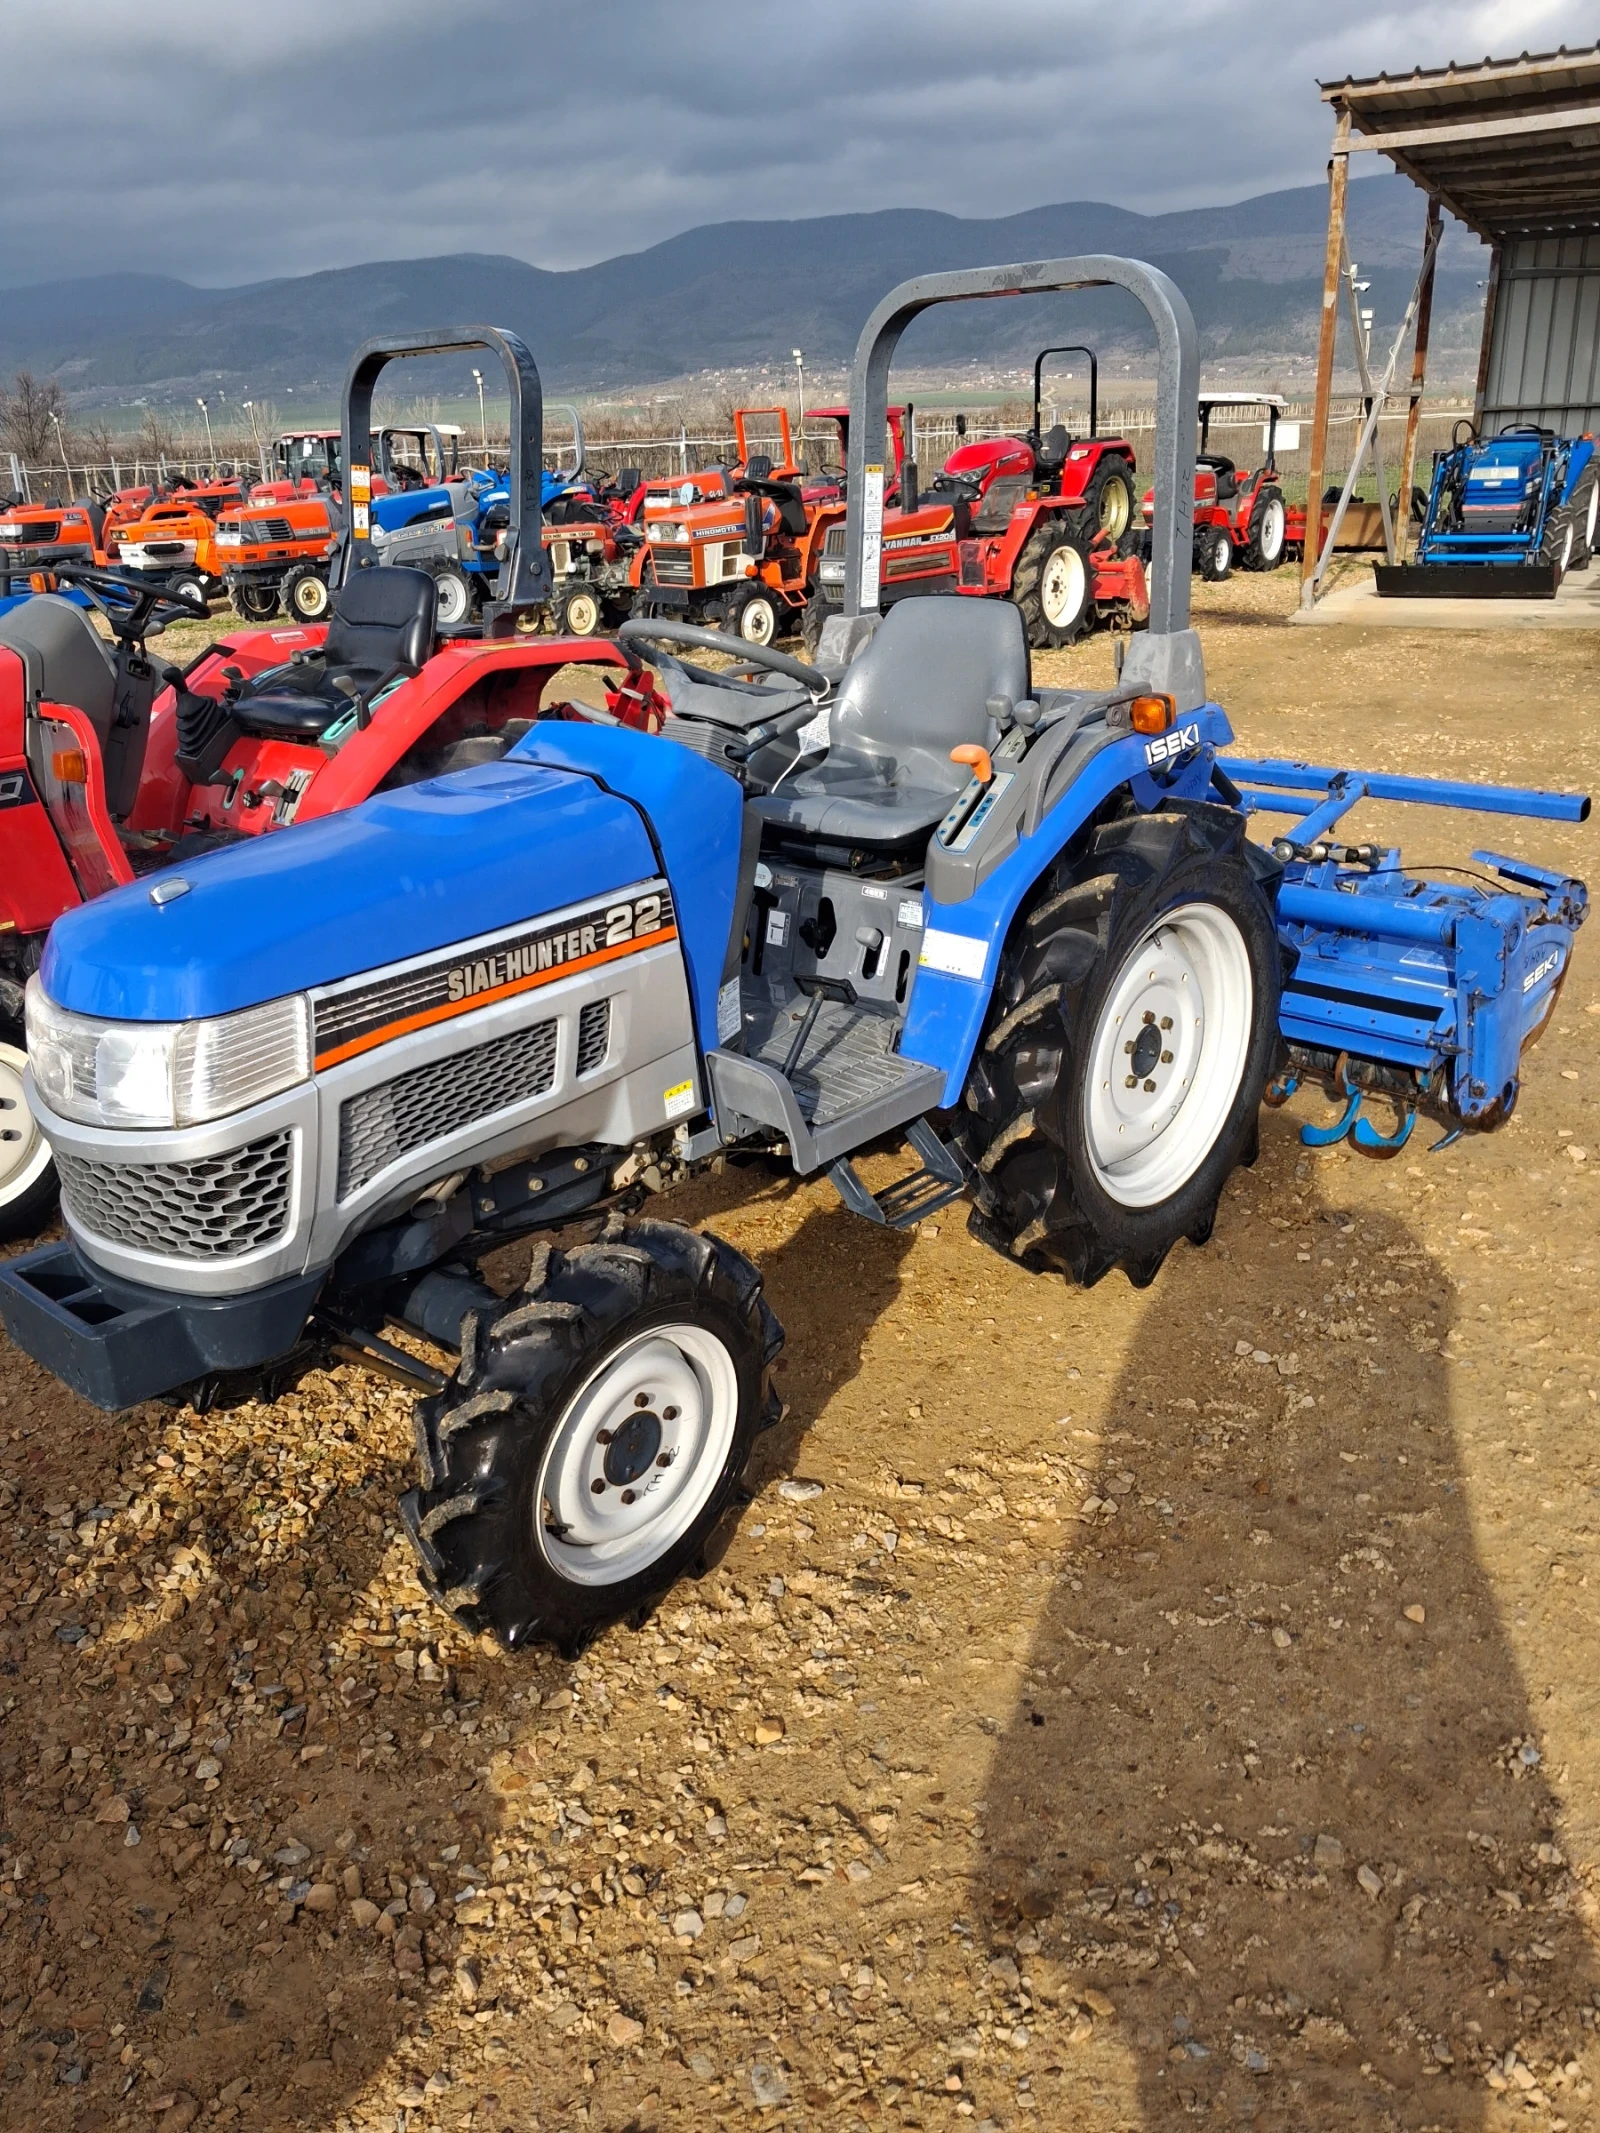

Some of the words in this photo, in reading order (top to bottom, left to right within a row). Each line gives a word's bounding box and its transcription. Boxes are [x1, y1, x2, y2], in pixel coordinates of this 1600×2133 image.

[695, 525, 737, 537] HINOMOTO
[884, 536, 922, 550] YANMAR
[1144, 722, 1200, 766] ISEKI
[448, 955, 505, 1002] SIAL
[506, 925, 598, 982] HUNTER
[605, 895, 662, 947] 22
[1523, 949, 1559, 994] SEKI
